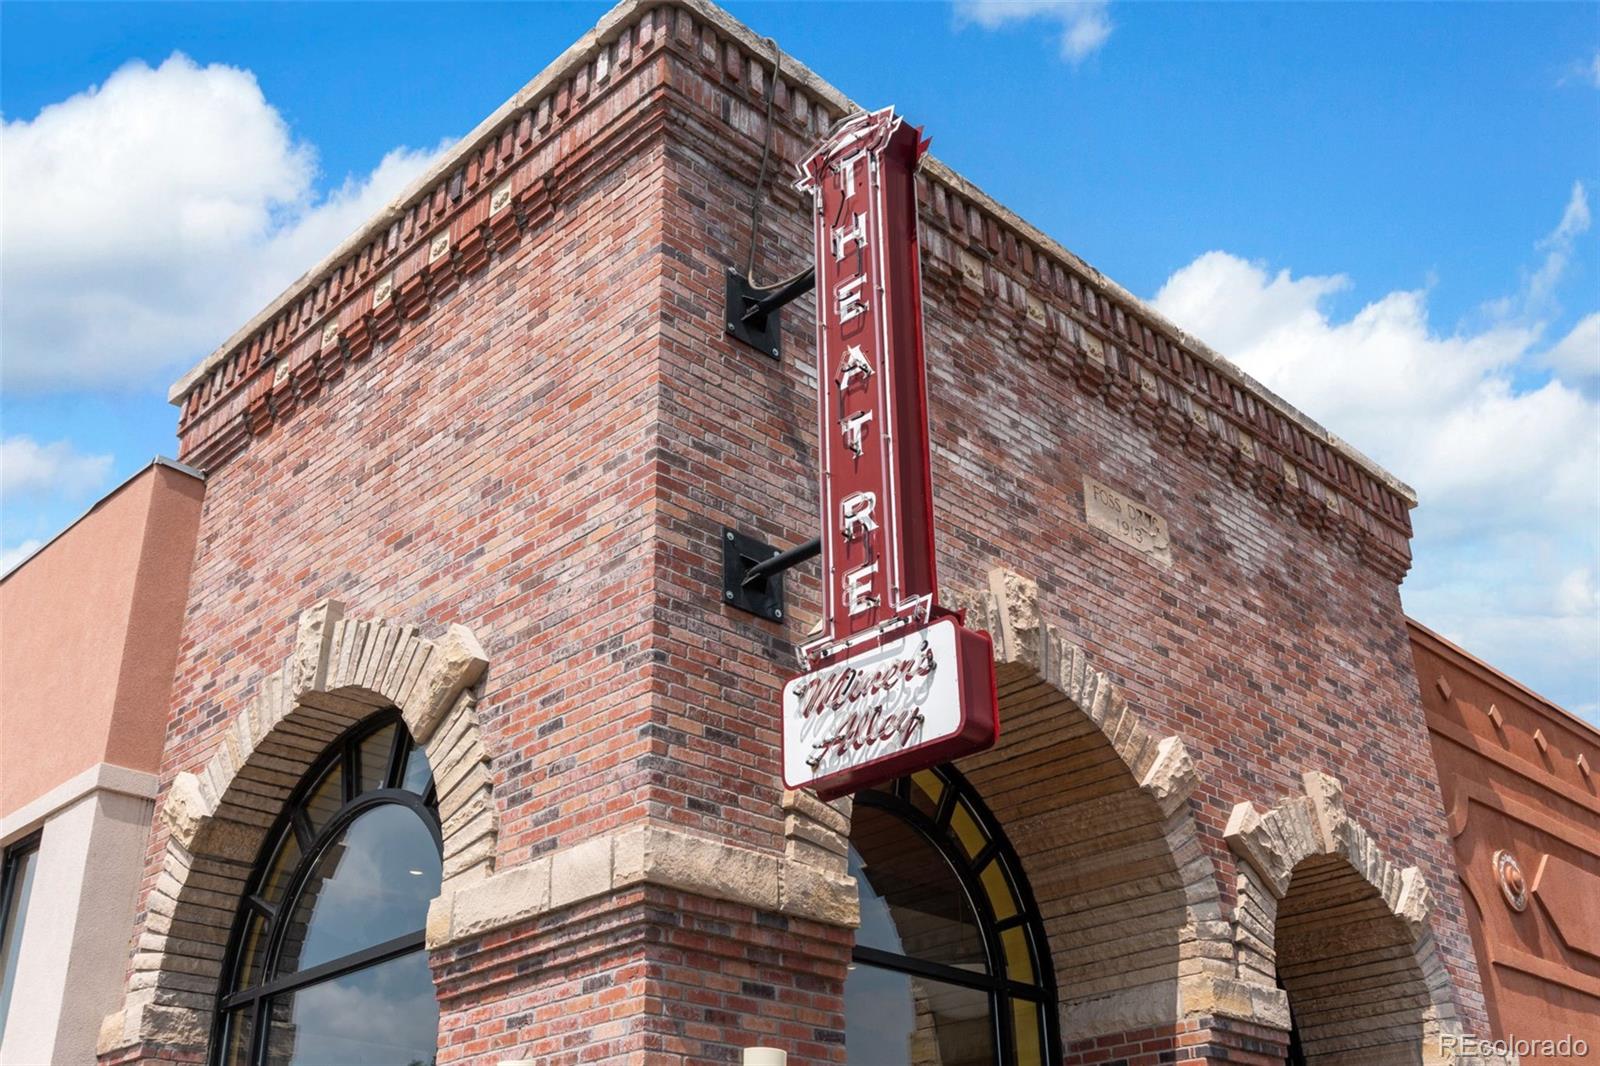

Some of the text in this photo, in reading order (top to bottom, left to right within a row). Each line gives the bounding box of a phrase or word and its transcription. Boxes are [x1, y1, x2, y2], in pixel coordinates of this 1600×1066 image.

[830, 149, 880, 617] THEATRE
[1093, 485, 1121, 513] FOSS
[1116, 518, 1143, 543] 1913
[794, 640, 937, 718] Miner's
[806, 705, 925, 767] Alley
